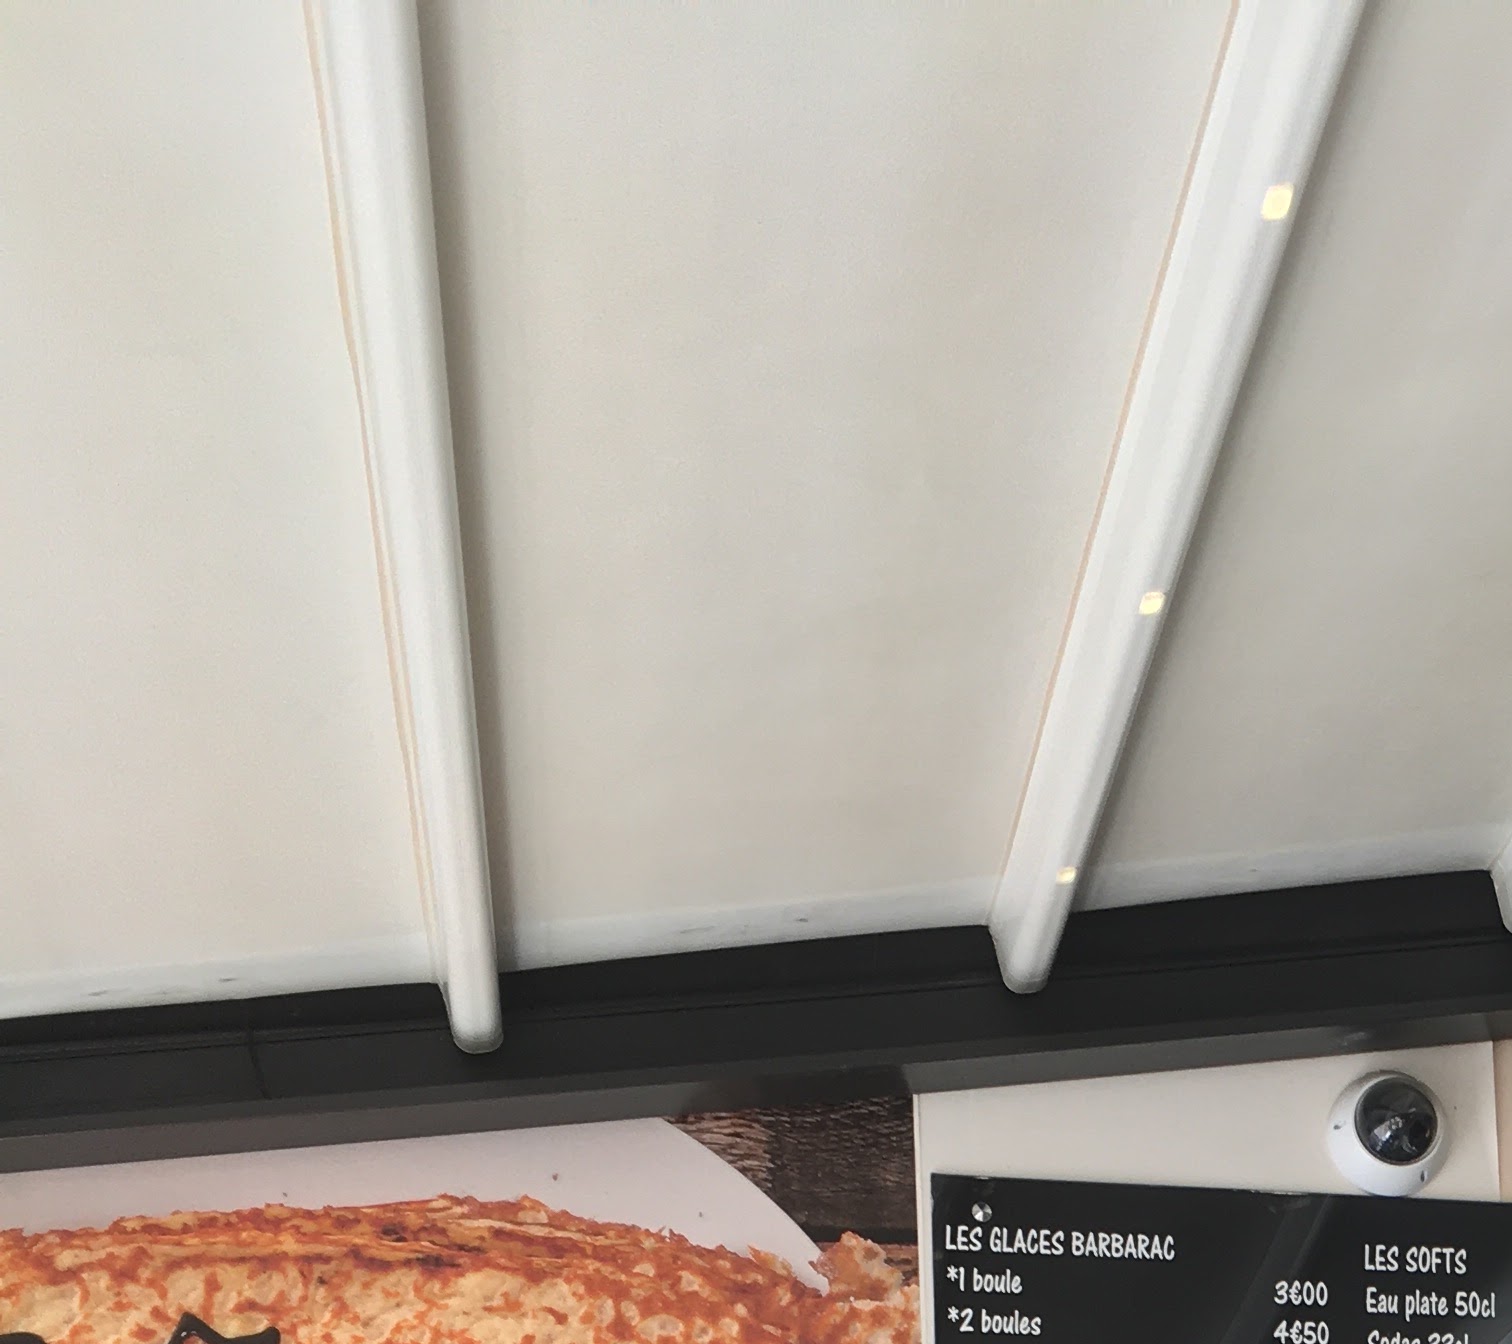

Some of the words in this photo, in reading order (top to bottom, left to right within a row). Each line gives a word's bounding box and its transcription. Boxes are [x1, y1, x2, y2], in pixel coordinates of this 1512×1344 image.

[945, 1224, 983, 1252] LES
[989, 1226, 1065, 1256] GLACES
[1071, 1231, 1176, 1261] BARBARAC
[1364, 1244, 1399, 1272] LES
[1405, 1245, 1467, 1275] SOFTS
[1365, 1286, 1399, 1314] Eau
[1405, 1289, 1449, 1322] plate
[1454, 1290, 1496, 1318] 50cl
